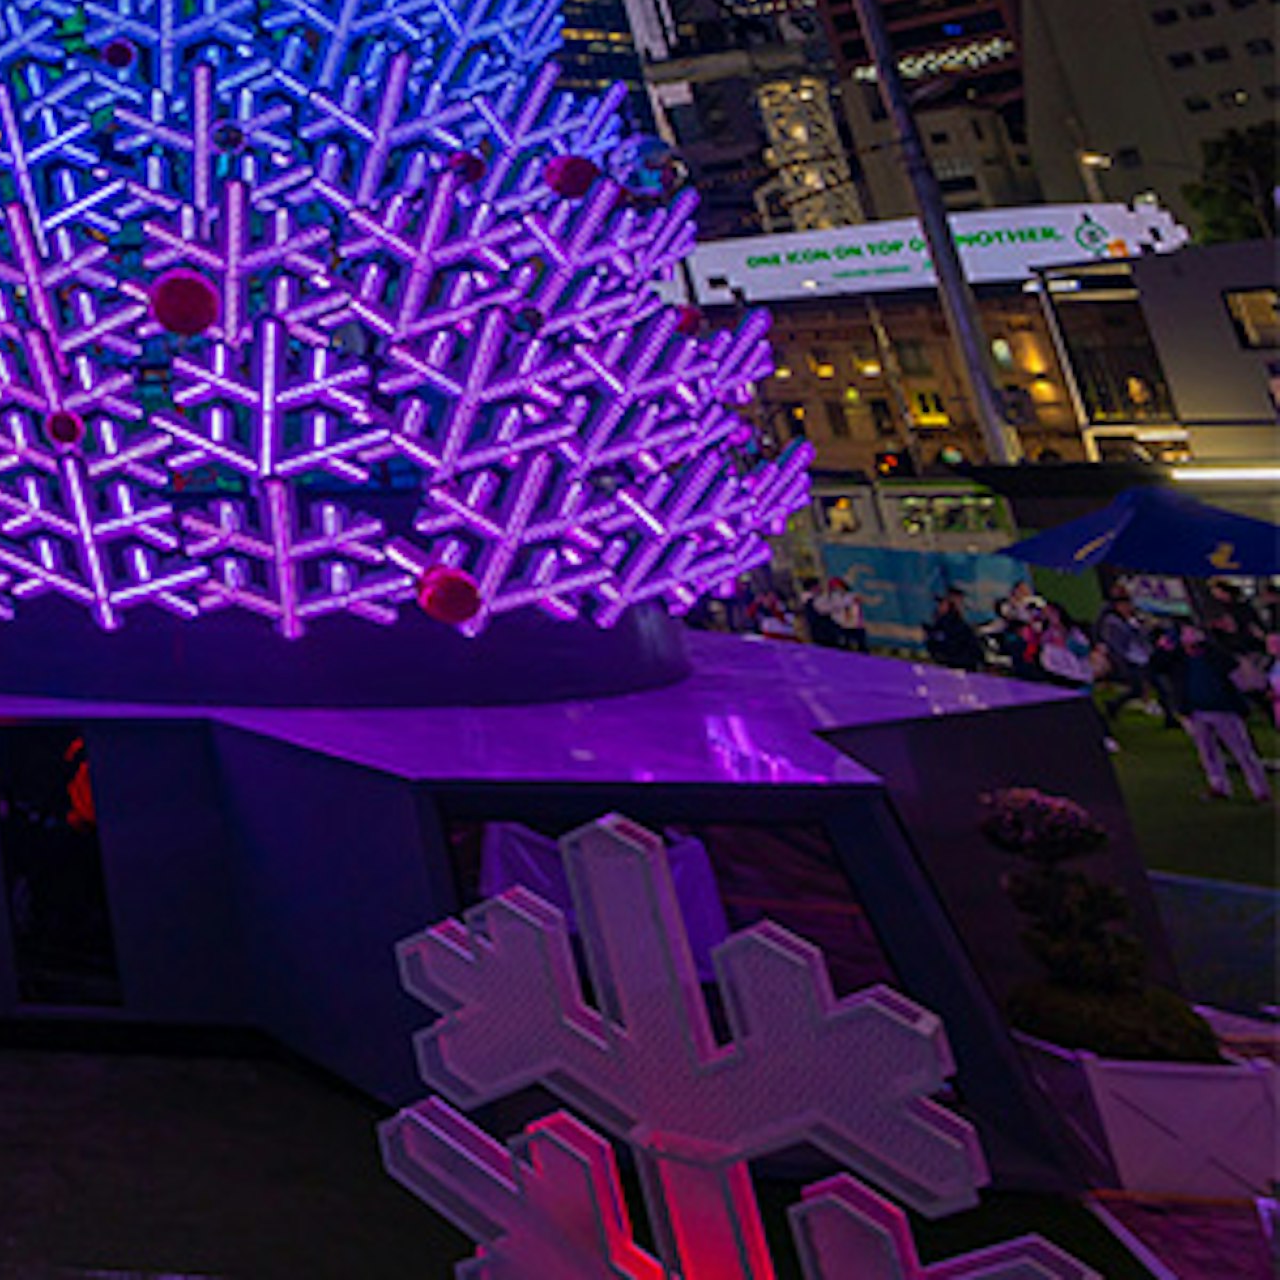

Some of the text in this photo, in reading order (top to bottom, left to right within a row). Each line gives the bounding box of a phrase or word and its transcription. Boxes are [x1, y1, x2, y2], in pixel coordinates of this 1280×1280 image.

[746, 253, 781, 268] ONE
[786, 248, 831, 264] ICON
[833, 245, 863, 260] ON
[867, 239, 904, 256] TOP
[955, 226, 1065, 247] NOTHER.
